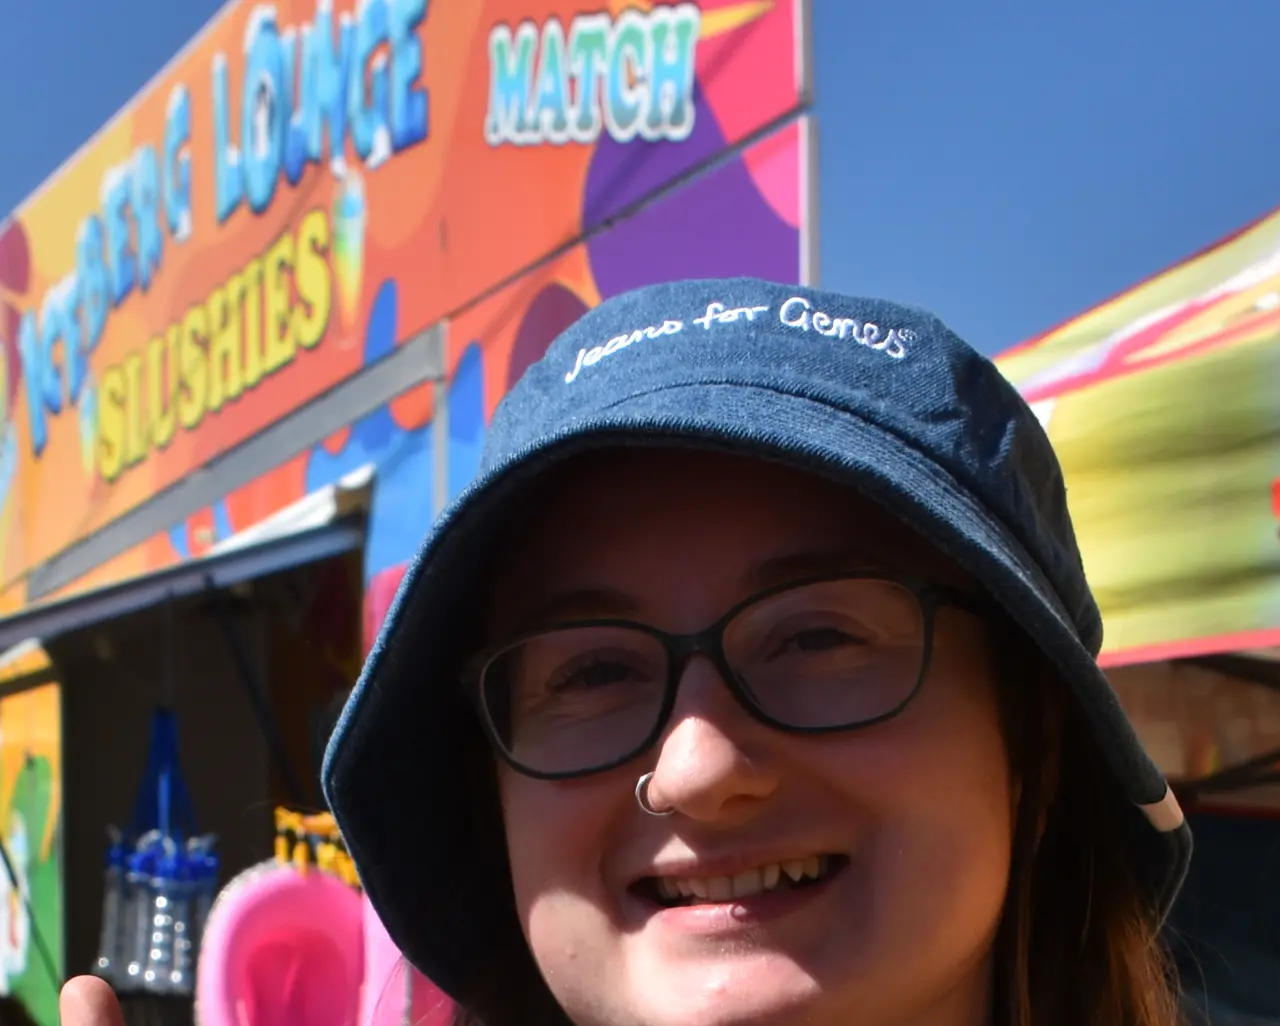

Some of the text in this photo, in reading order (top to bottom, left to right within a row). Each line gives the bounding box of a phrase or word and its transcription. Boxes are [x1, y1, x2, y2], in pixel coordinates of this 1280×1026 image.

[484, 2, 701, 147] MATCH
[18, 0, 429, 459] ICEBERG LOUNGE
[99, 209, 332, 484] SLUSHIES
[565, 321, 684, 384] Jeans
[693, 302, 770, 330] for
